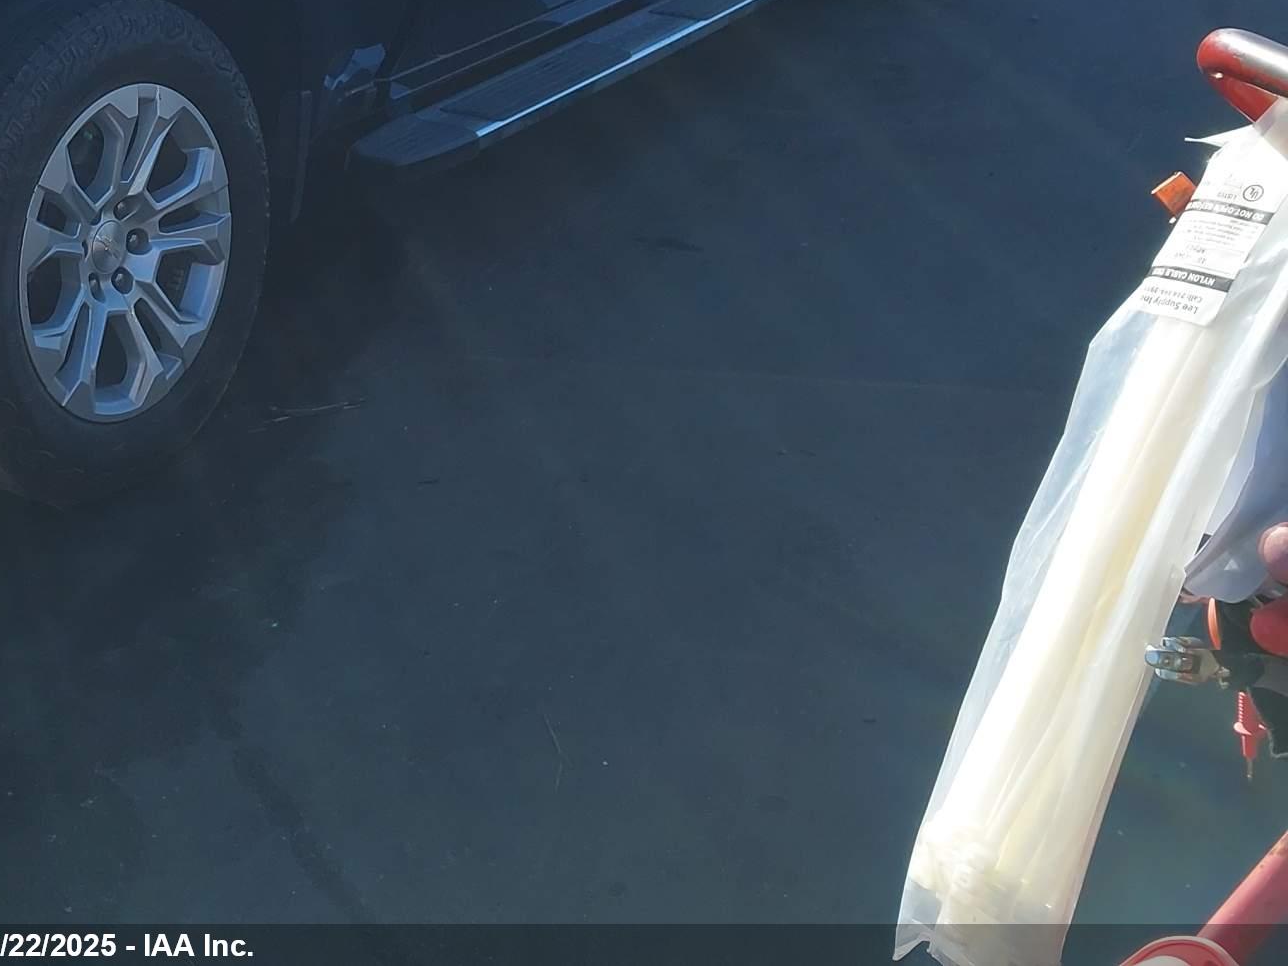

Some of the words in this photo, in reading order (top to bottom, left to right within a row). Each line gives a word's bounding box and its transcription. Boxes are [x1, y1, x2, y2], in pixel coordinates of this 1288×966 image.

[1235, 209, 1254, 220] NOT
[1164, 269, 1188, 281] CABLE
[1188, 275, 1216, 287] NYLON
[1153, 295, 1180, 311] Supply
[1182, 302, 1199, 315] Lee
